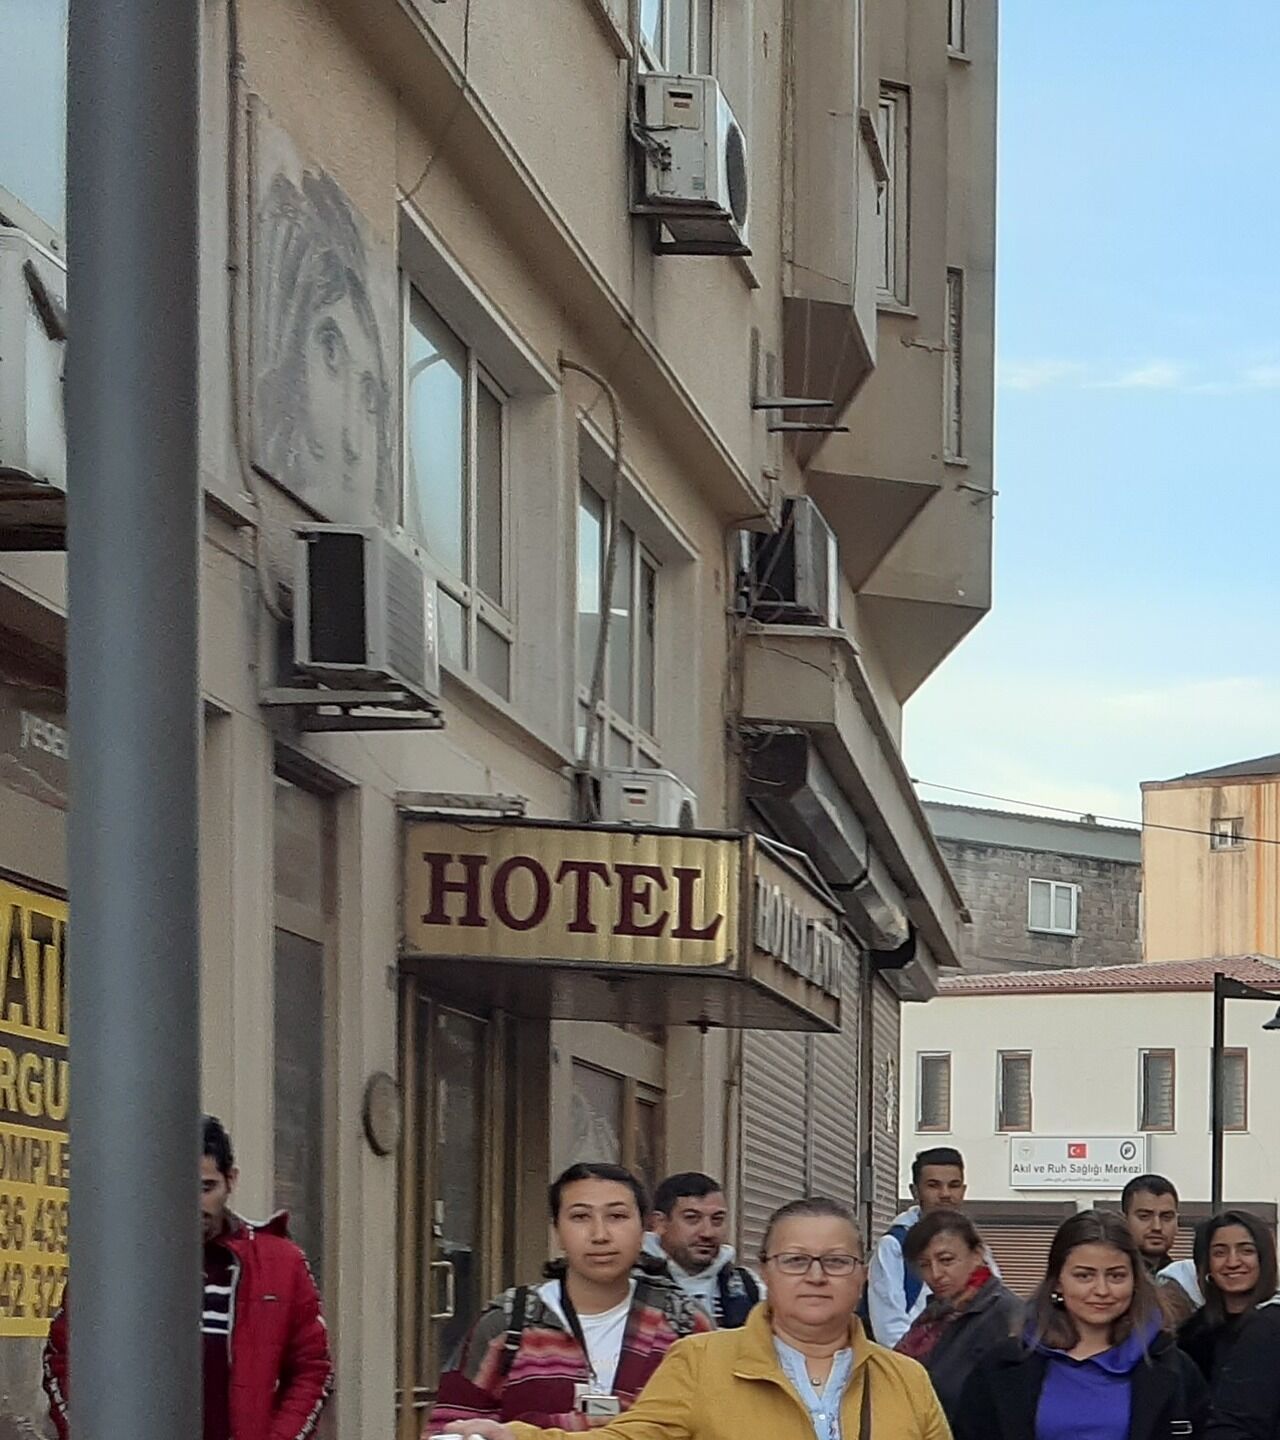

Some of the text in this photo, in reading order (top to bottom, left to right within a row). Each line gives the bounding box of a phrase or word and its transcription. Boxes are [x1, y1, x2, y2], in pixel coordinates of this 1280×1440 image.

[421, 851, 724, 941] HOTEL
[1013, 1163, 1142, 1176] Akıl ve Ruh Sağlığı Merkezi
